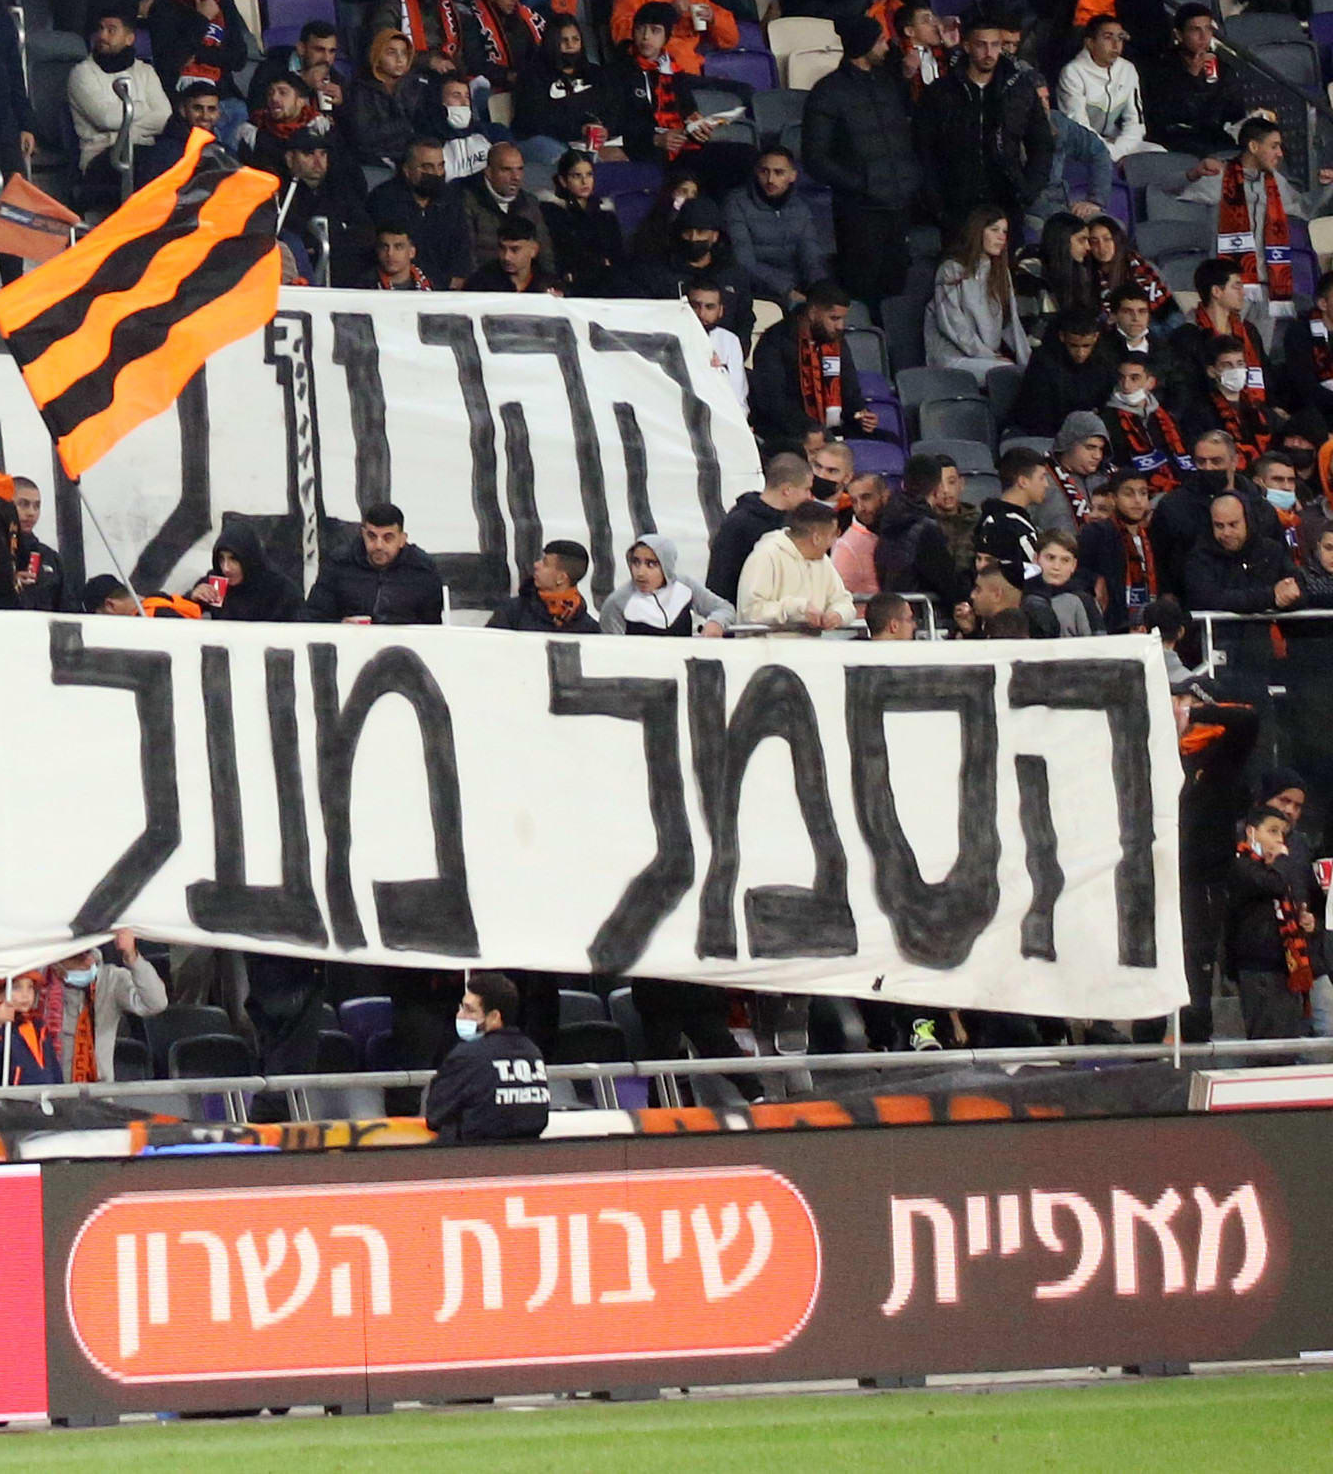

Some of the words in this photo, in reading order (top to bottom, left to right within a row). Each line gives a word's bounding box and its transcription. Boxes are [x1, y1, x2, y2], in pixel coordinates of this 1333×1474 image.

[50, 620, 480, 958] מעל
[547, 640, 1157, 974] הסמל
[115, 1223, 393, 1359] השרון
[434, 1196, 774, 1323] שיבולת
[880, 1181, 1269, 1317] מאפיית
